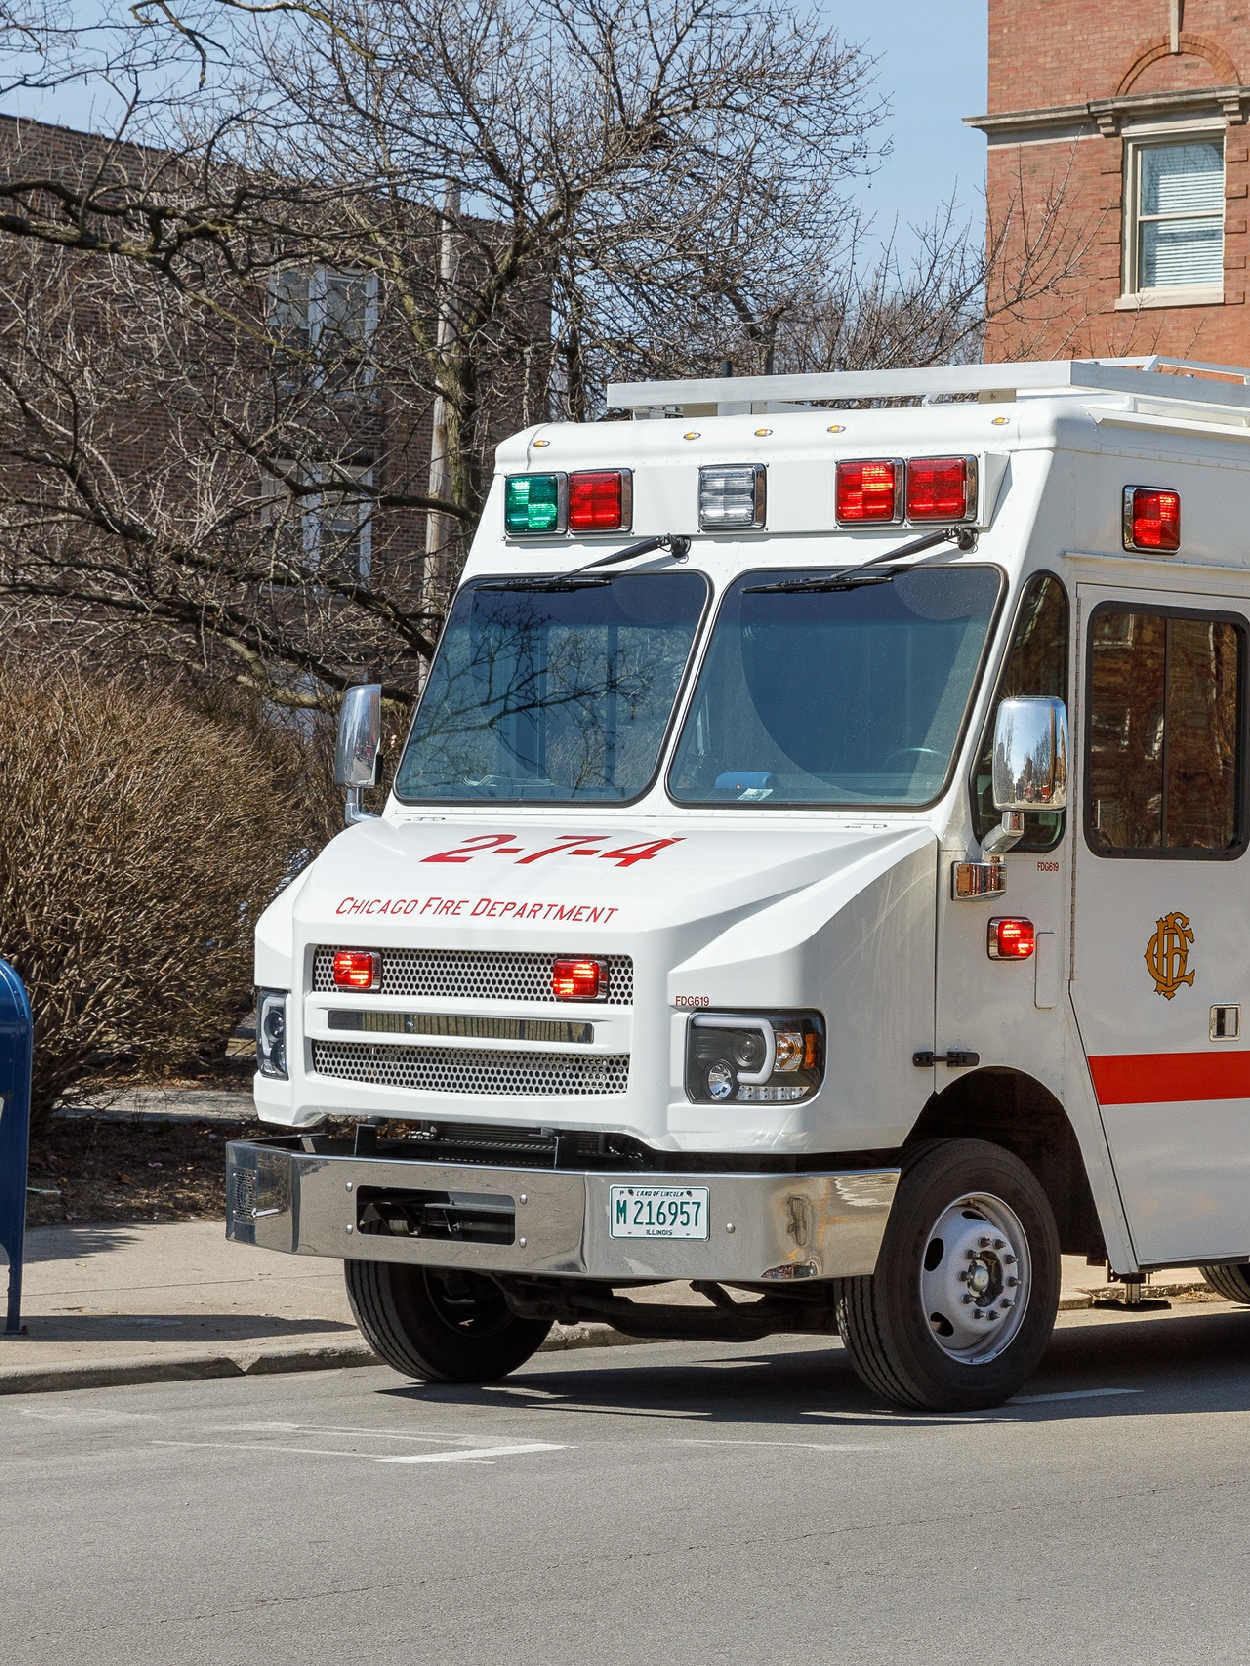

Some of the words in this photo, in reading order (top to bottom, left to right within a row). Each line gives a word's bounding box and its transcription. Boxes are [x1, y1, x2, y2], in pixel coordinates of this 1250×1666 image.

[418, 834, 688, 868] 2-7-4
[1036, 861, 1060, 872] FDG619
[335, 896, 419, 916] CHICAGO
[419, 896, 472, 917] FIRE
[470, 897, 619, 924] DEPARTMENT
[675, 995, 710, 1007] FDG619
[633, 1199, 702, 1227] 216957
